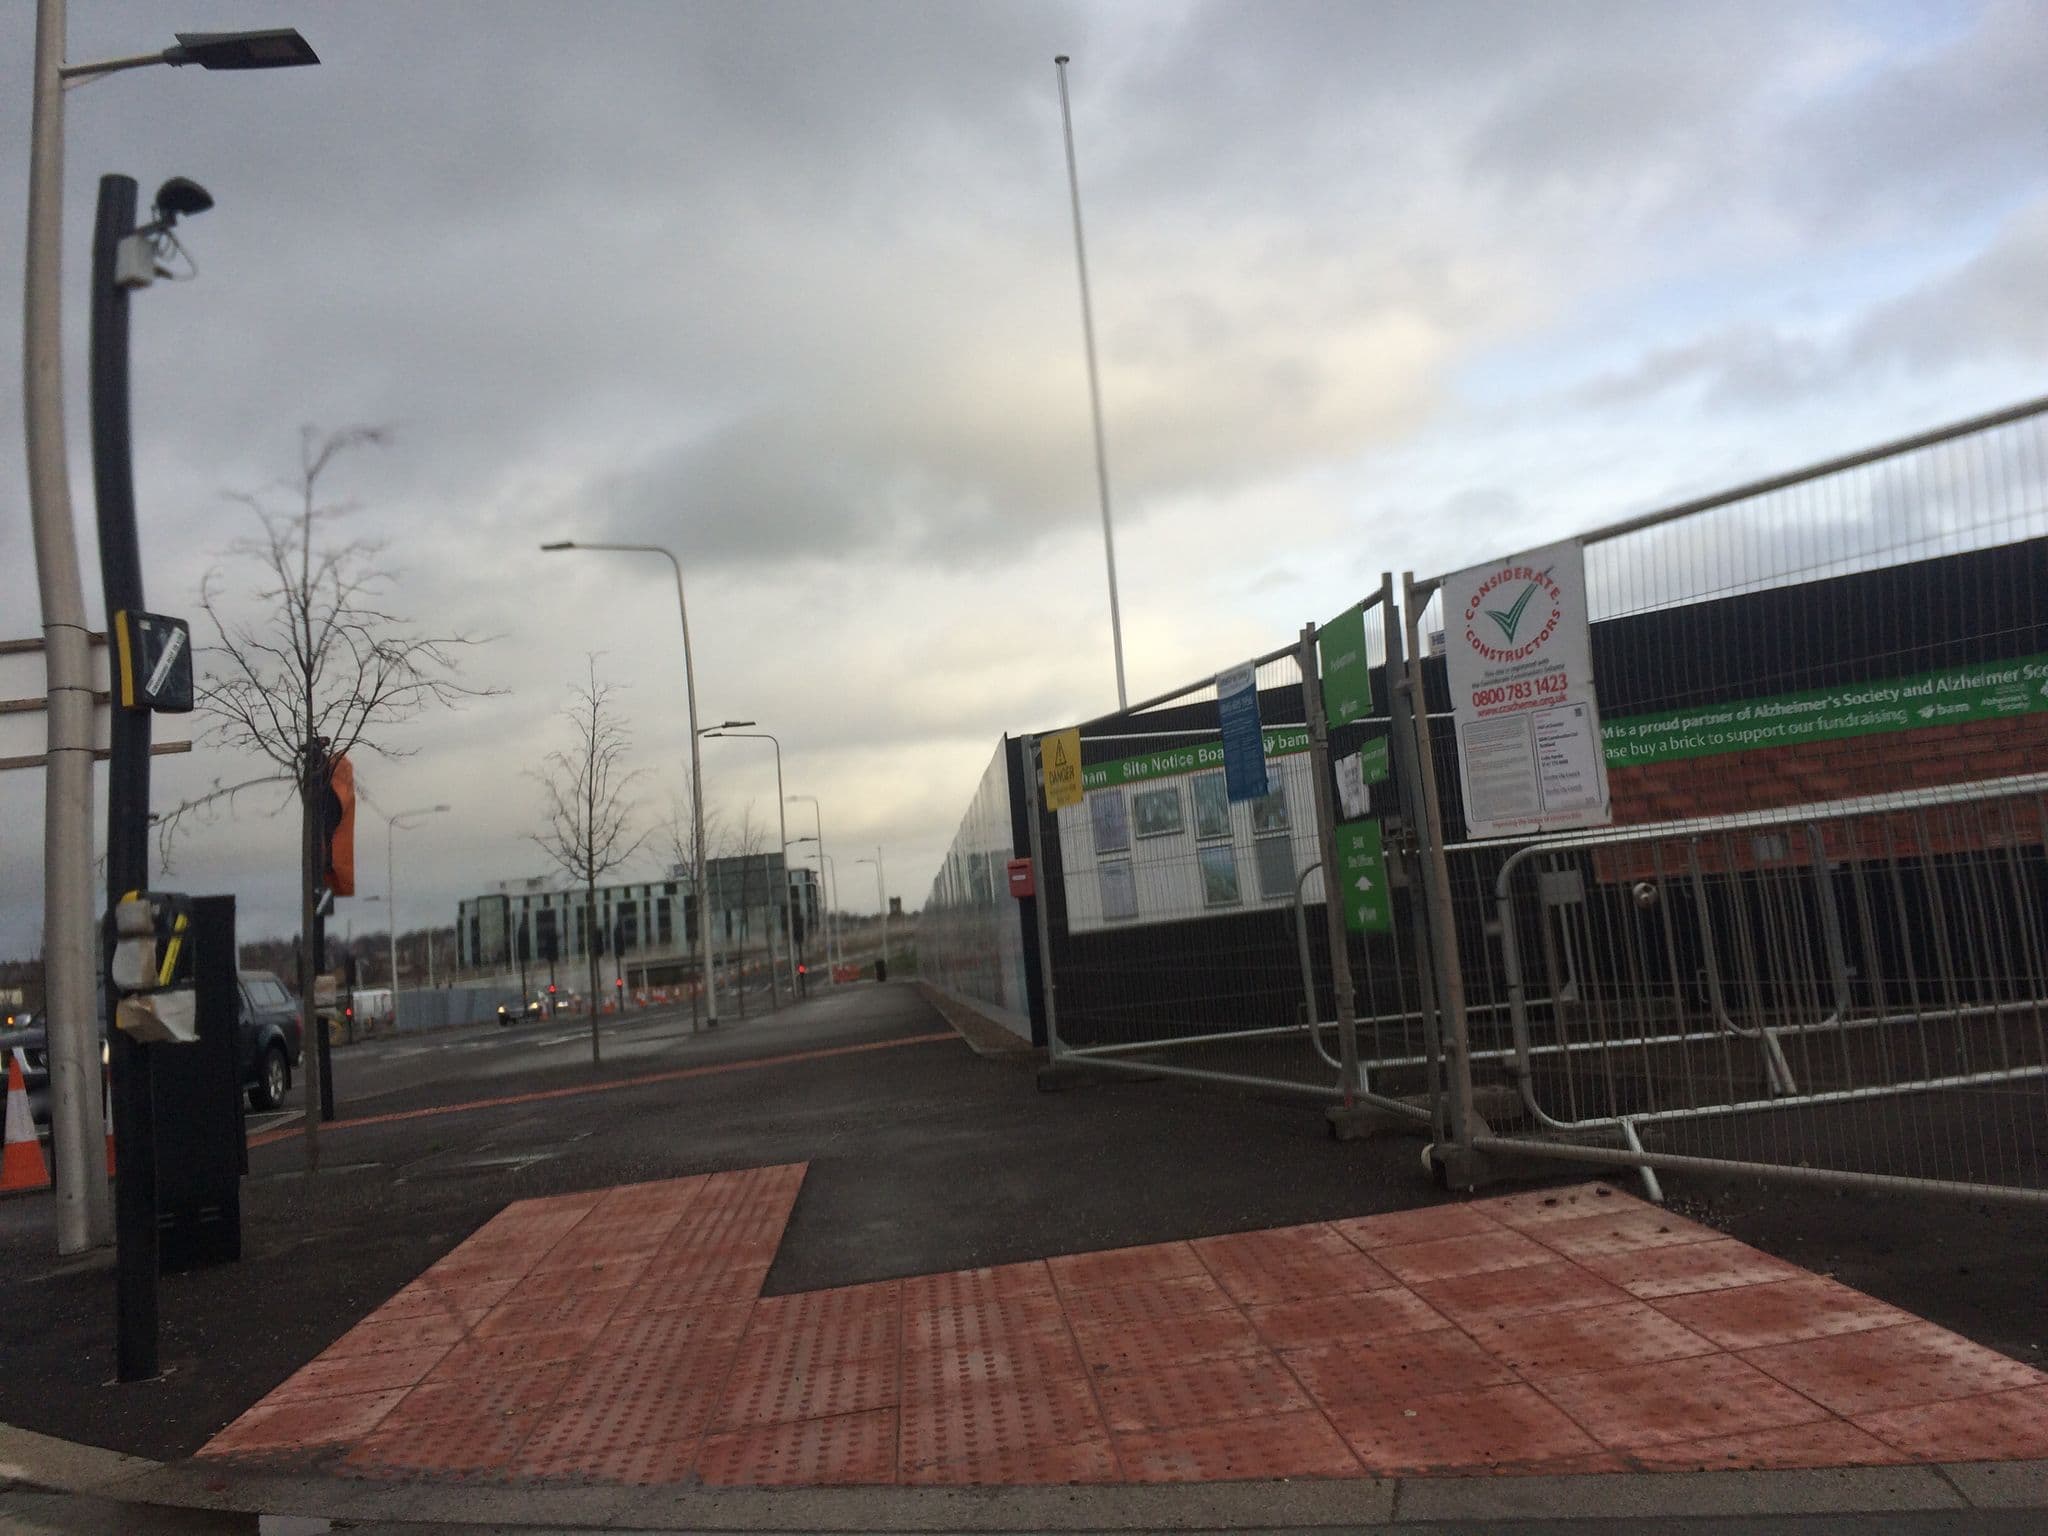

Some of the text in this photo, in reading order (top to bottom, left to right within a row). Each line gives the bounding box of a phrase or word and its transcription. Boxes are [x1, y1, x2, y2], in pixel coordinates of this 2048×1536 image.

[1465, 567, 1560, 620] CONSIDERATE
[1466, 609, 1561, 661] CONSTRUCTORS
[1472, 672, 1568, 708] 0800 783 1423
[1616, 725, 1627, 738] is
[1629, 725, 1637, 736] a
[1639, 717, 1679, 737] proud
[1682, 712, 1734, 731] partner
[1736, 706, 1752, 721] of
[1754, 695, 1841, 718] Alzheimer's
[1843, 687, 1900, 706] Society
[1903, 679, 1933, 698] and
[1936, 668, 2019, 692] Alzheimer
[1937, 702, 1971, 714] bam
[1278, 732, 1309, 750] bam
[1631, 741, 1657, 757] buy
[1659, 741, 1668, 752] a
[1670, 733, 1705, 751] brick
[1708, 731, 1724, 745] to
[1727, 722, 1785, 743] support
[1788, 721, 1815, 734] our
[1816, 709, 1908, 731] fundraising
[1123, 747, 1224, 778] Site Notice Boa
